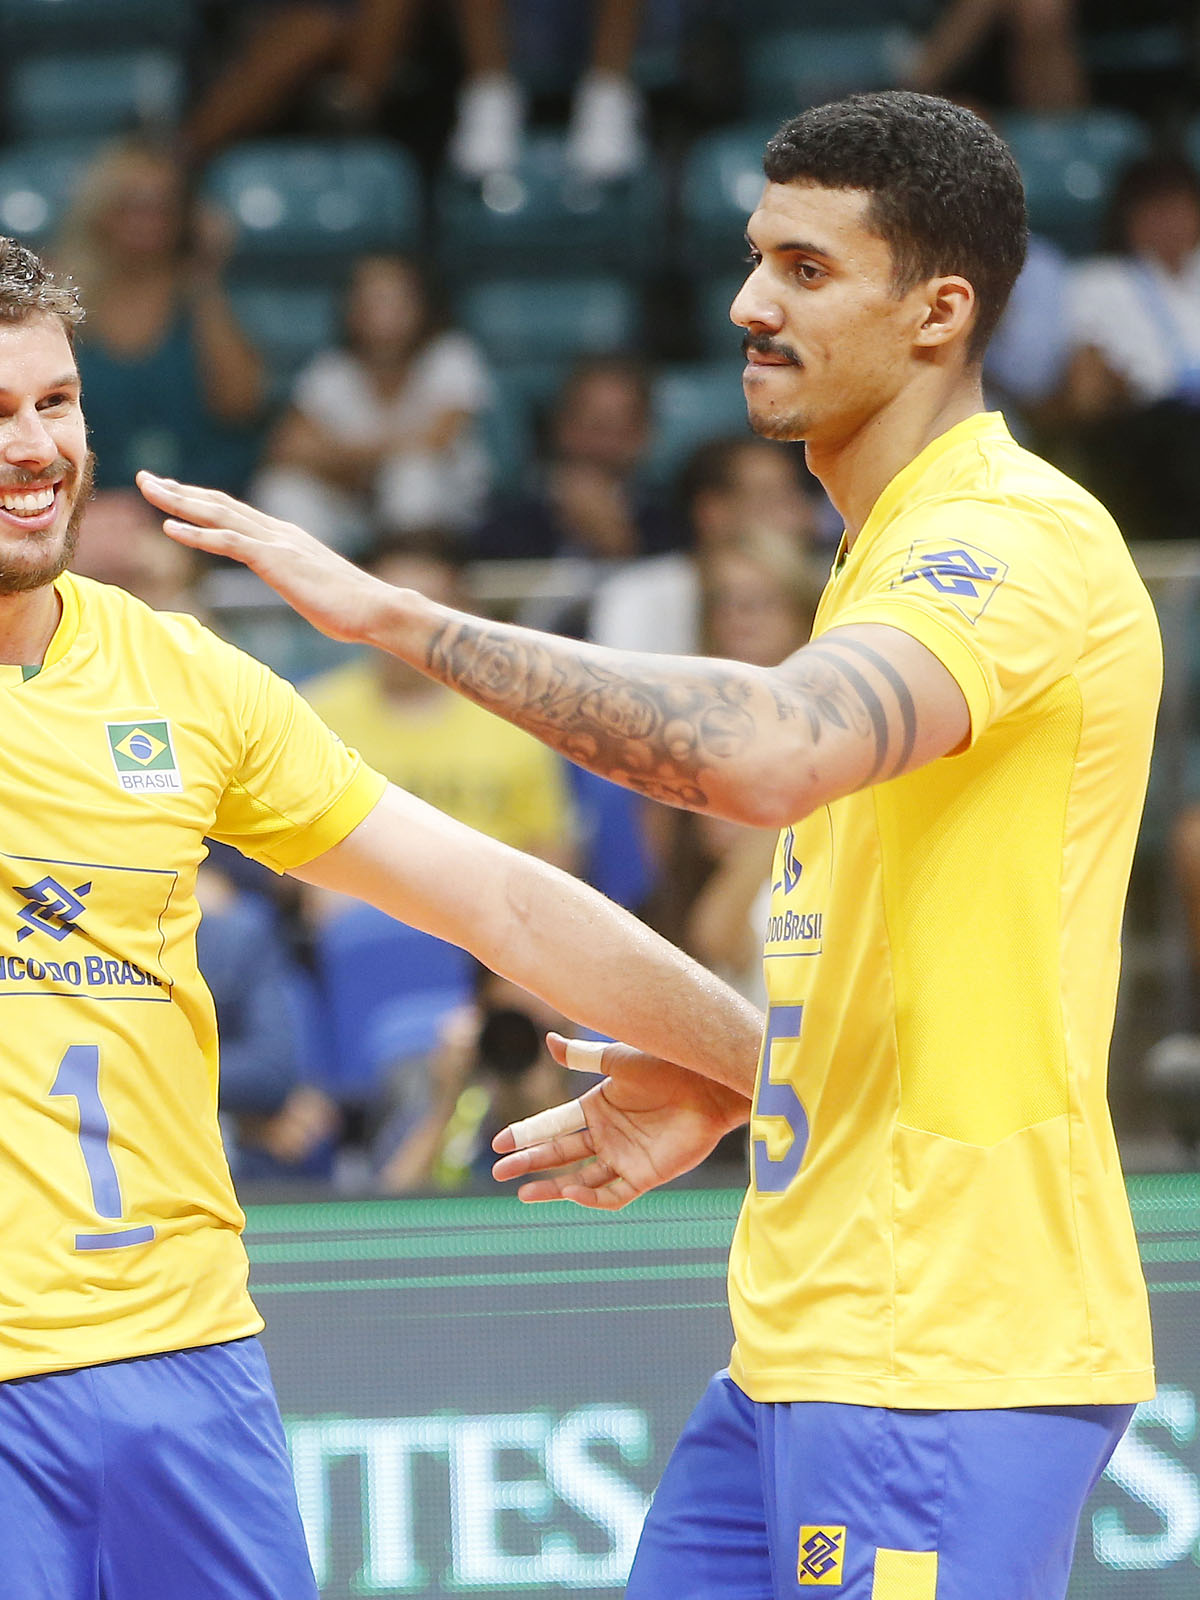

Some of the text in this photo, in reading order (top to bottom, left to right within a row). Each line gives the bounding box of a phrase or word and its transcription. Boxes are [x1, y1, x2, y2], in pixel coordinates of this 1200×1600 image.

[121, 774, 180, 789] BRASIL
[48, 1045, 123, 1219] 1
[754, 1005, 810, 1193] 5
